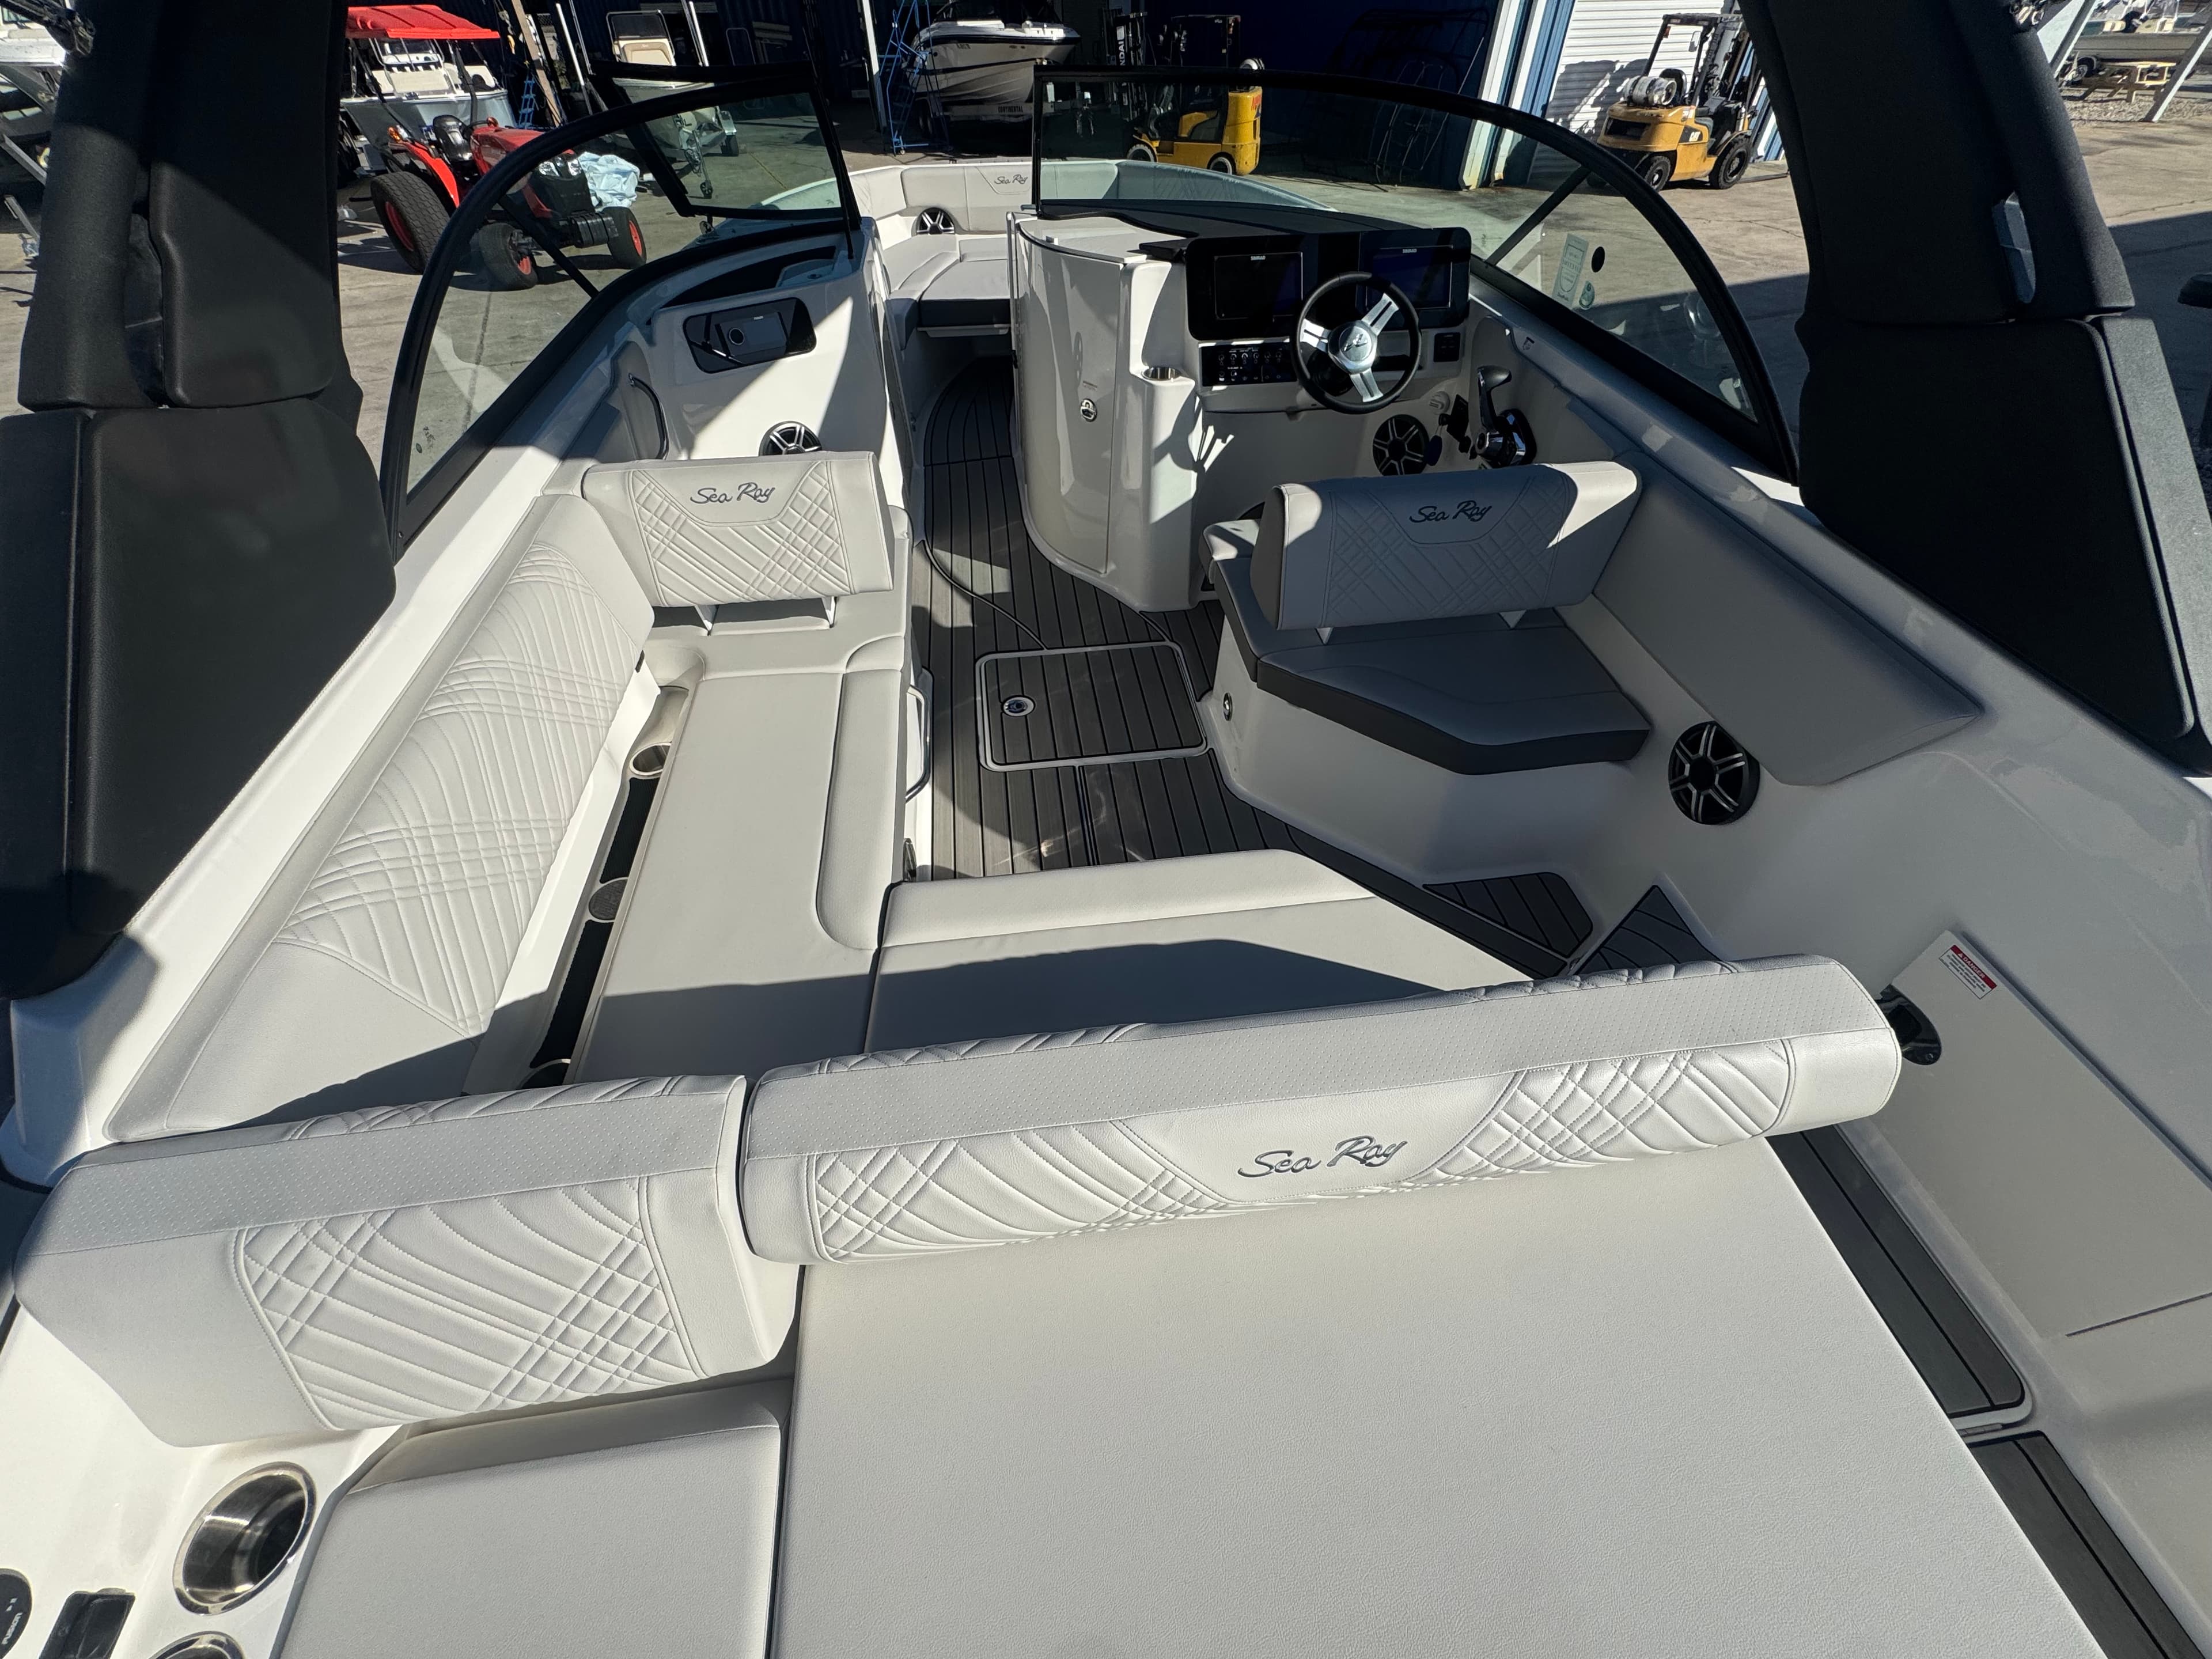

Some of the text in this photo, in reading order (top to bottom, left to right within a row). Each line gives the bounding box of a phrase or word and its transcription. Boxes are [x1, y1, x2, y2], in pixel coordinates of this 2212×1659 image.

[1689, 131, 1700, 142] CAT
[994, 174, 1028, 184] Sea Ray
[690, 482, 776, 504] Sea Ray
[1409, 500, 1493, 522] Sea Ray
[1962, 957, 1986, 978] DANGER
[1238, 1135, 1408, 1177] Sea Ray
